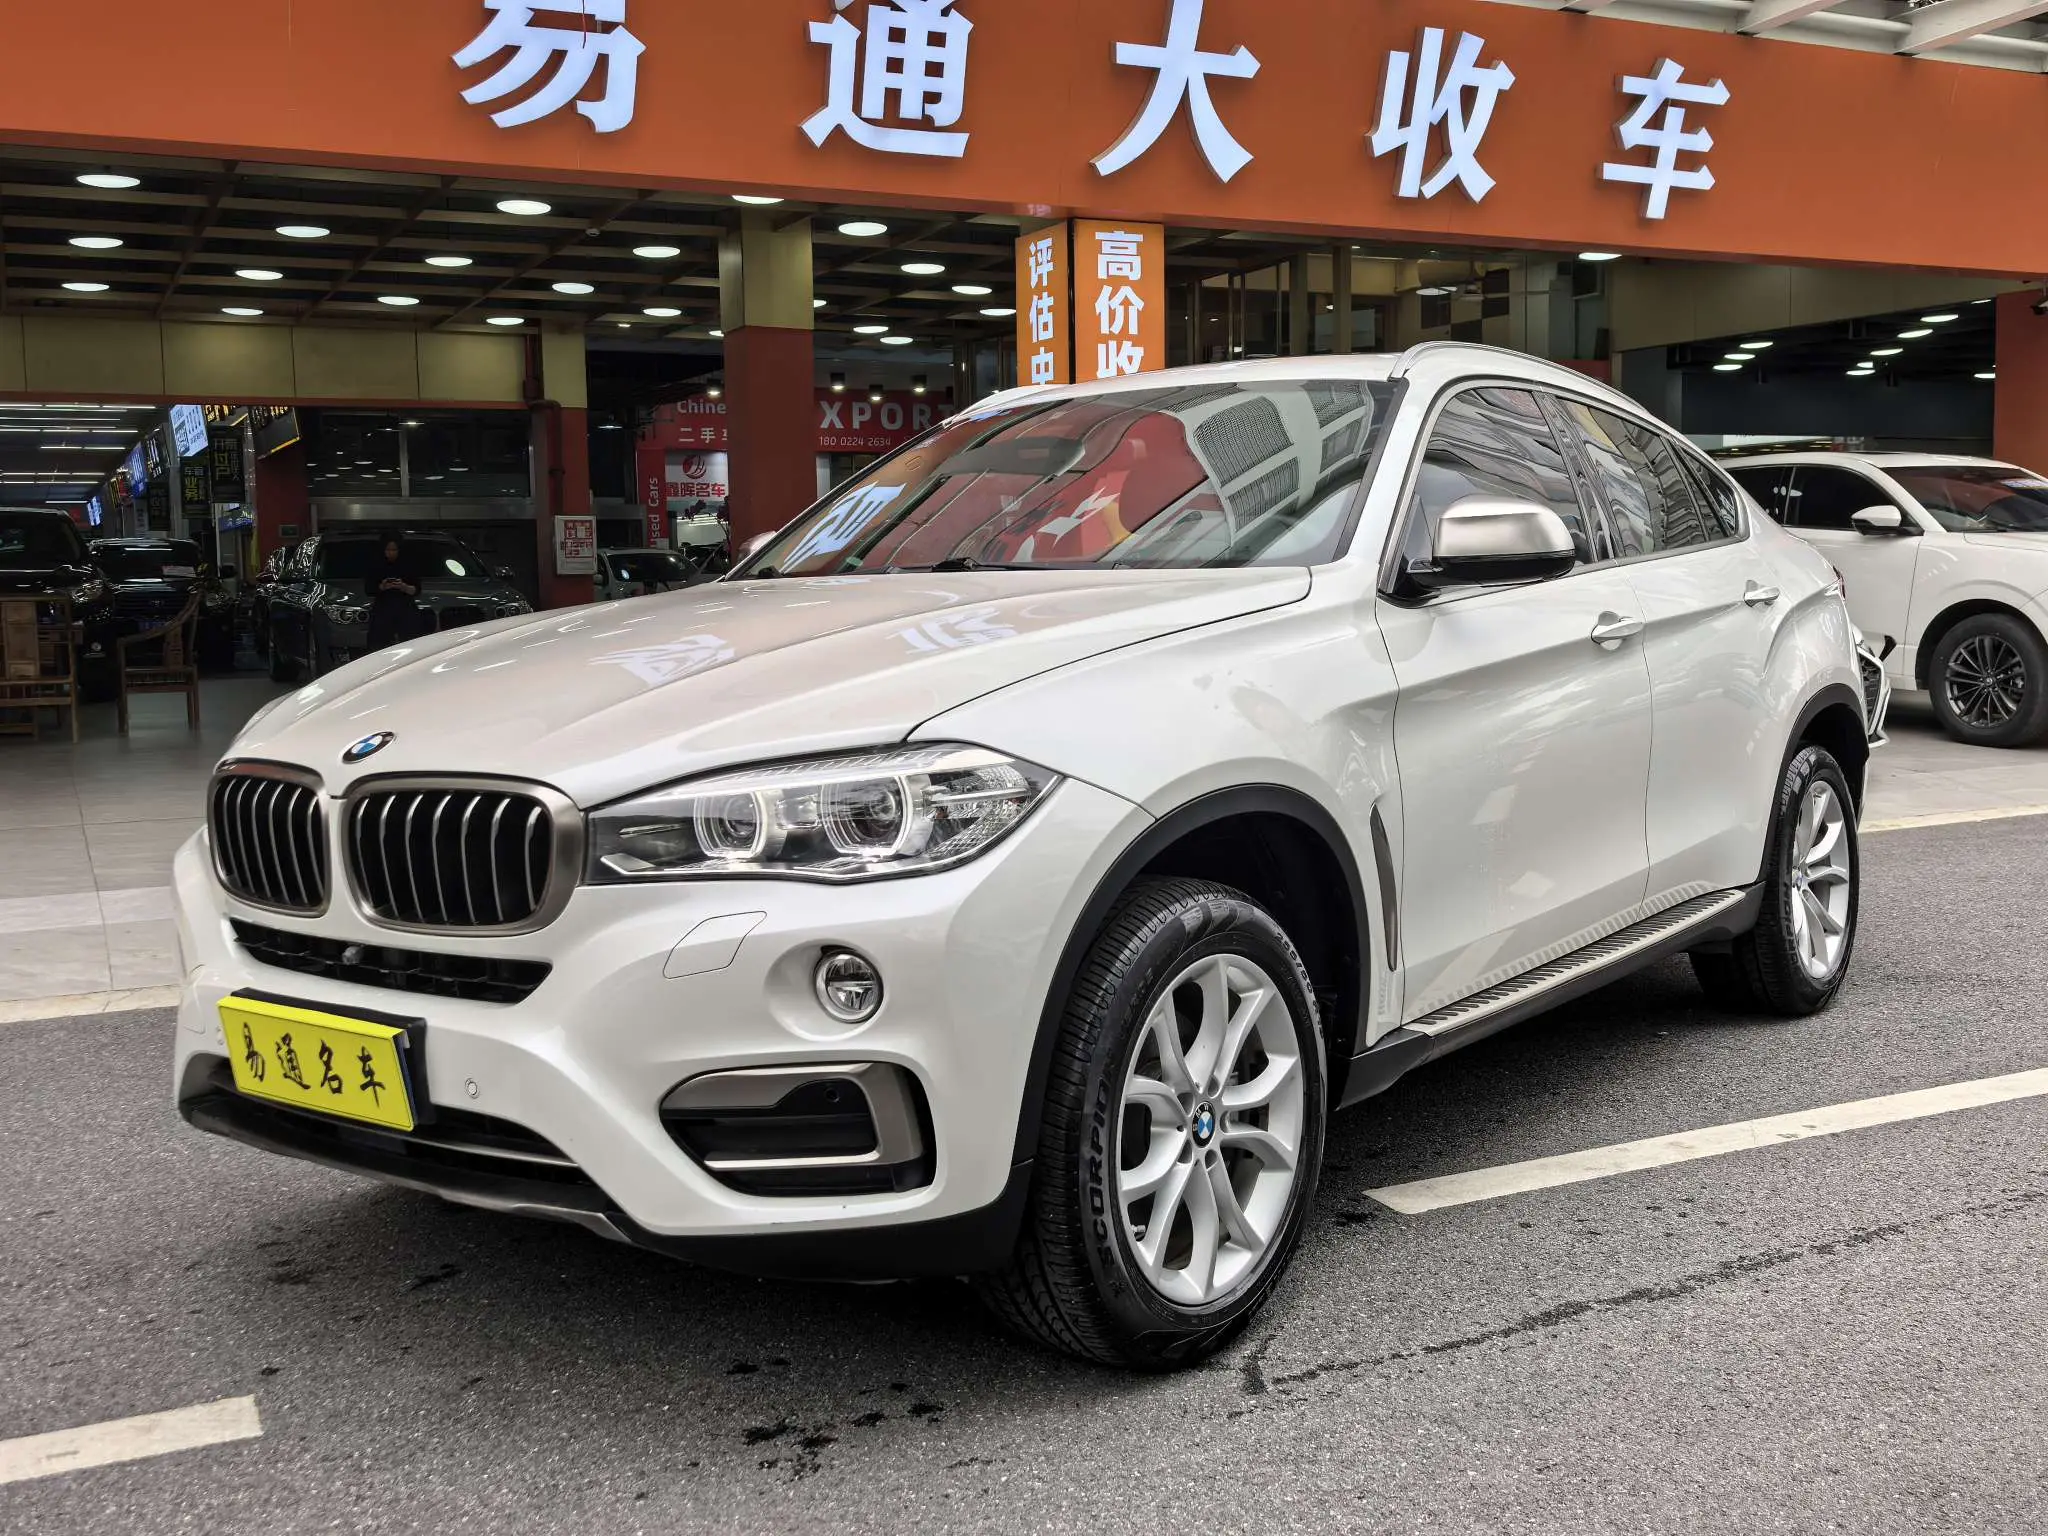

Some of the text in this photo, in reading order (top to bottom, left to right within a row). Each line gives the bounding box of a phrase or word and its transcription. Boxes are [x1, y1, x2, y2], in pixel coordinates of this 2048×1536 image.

[676, 399, 727, 414] Chine
[819, 436, 837, 446] 180
[840, 436, 865, 446] 0224
[868, 437, 892, 447] 2634
[647, 476, 660, 507] Cars
[242, 1021, 387, 1109] 易通名车
